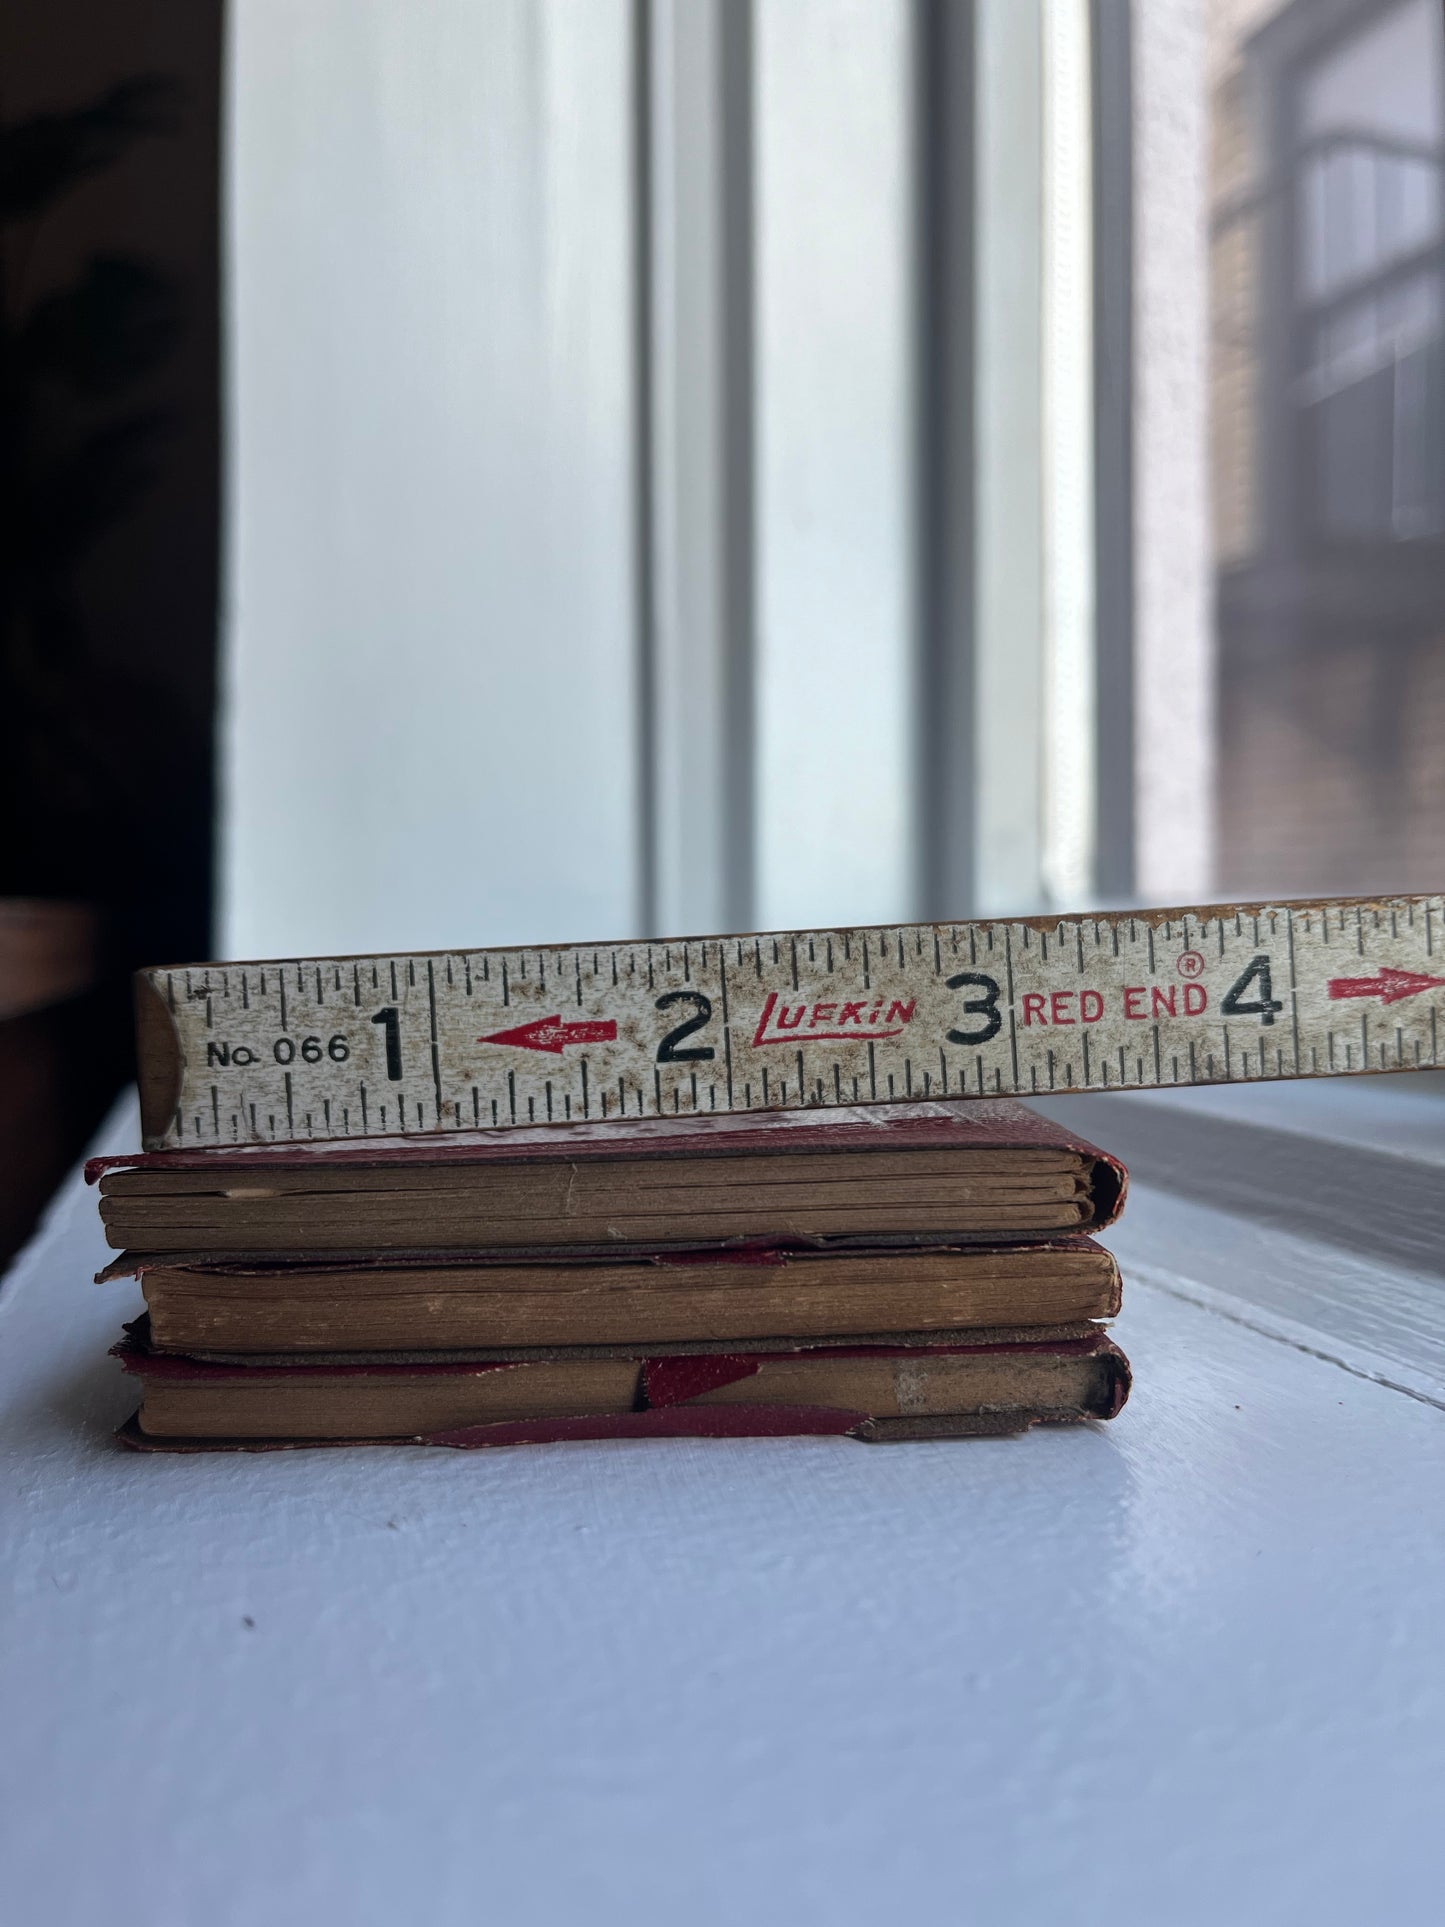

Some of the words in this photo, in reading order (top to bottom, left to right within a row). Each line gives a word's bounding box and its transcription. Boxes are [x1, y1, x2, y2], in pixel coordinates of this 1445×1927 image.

[945, 972, 1001, 1046] 3
[1022, 990, 1104, 1026] RED
[1123, 983, 1207, 1020] END
[1220, 955, 1283, 1026] 4
[273, 1034, 350, 1066] 066
[371, 1007, 403, 1081] 1
[654, 991, 715, 1063] 2
